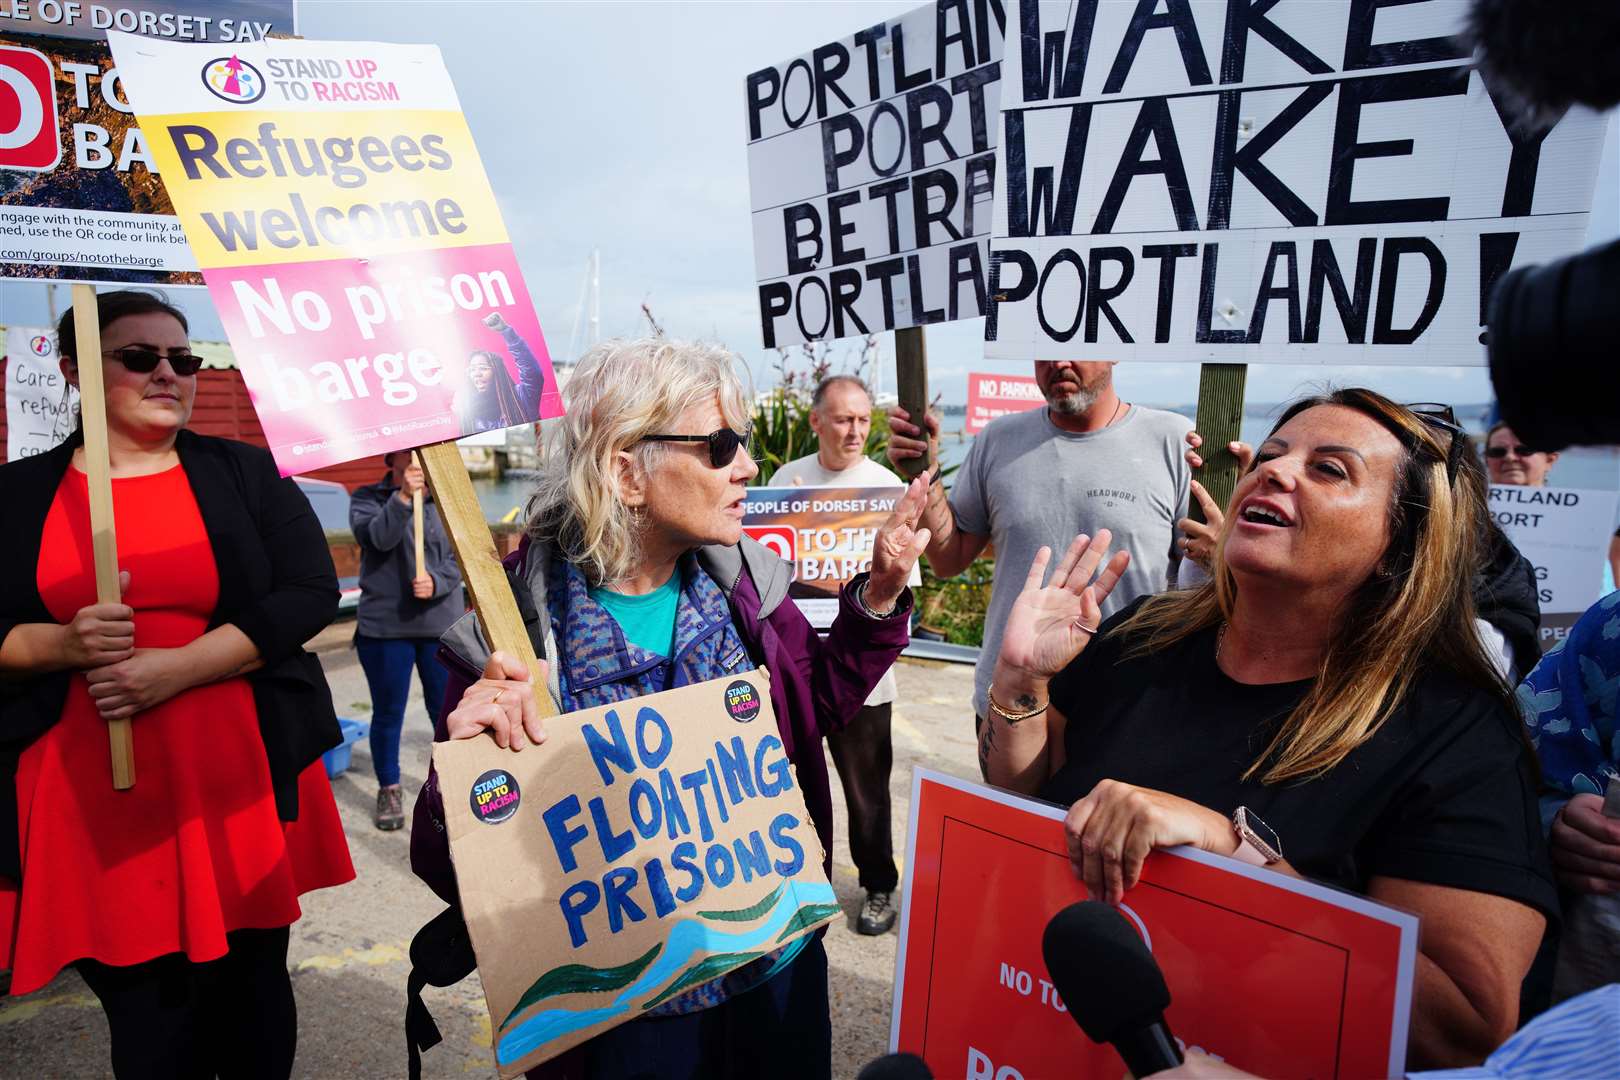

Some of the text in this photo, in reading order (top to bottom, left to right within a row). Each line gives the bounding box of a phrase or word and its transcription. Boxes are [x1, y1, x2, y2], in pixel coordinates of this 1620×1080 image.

[38, 0, 81, 25] OF
[91, 5, 211, 40] DORSET
[219, 18, 272, 42] SAY
[266, 57, 377, 80] STAND UP
[274, 81, 400, 102] TO RACISM
[821, 61, 1001, 195] PORT
[73, 122, 161, 174] BA
[167, 122, 453, 189] Refugees
[1004, 64, 1572, 238] WAKEY
[43, 213, 70, 225] with
[74, 215, 94, 226] the
[98, 217, 169, 232] community,
[200, 193, 468, 252] welcome
[28, 228, 49, 237] use
[52, 227, 72, 238] the
[76, 229, 94, 240] QR
[97, 231, 127, 242] code
[130, 234, 143, 242] or
[146, 233, 166, 244] link
[231, 268, 516, 340] No prison
[758, 238, 990, 350] PORTLA
[16, 364, 57, 388] Care
[260, 348, 446, 412] barge
[979, 380, 998, 398] NO
[792, 501, 812, 512] OF
[813, 500, 866, 512] DORSET
[869, 499, 896, 511] SAY
[799, 528, 838, 552] TO
[1541, 626, 1573, 640] PE
[727, 685, 750, 698] STAND
[729, 693, 752, 706] UP TO
[731, 699, 759, 714] RACISM
[581, 706, 673, 786] NO
[474, 774, 507, 796] STAND
[476, 784, 509, 805] UP TO
[480, 790, 519, 816] RACISM
[542, 734, 794, 874] FLOATING
[558, 813, 805, 949] PRISONS
[1000, 962, 1033, 996] NO
